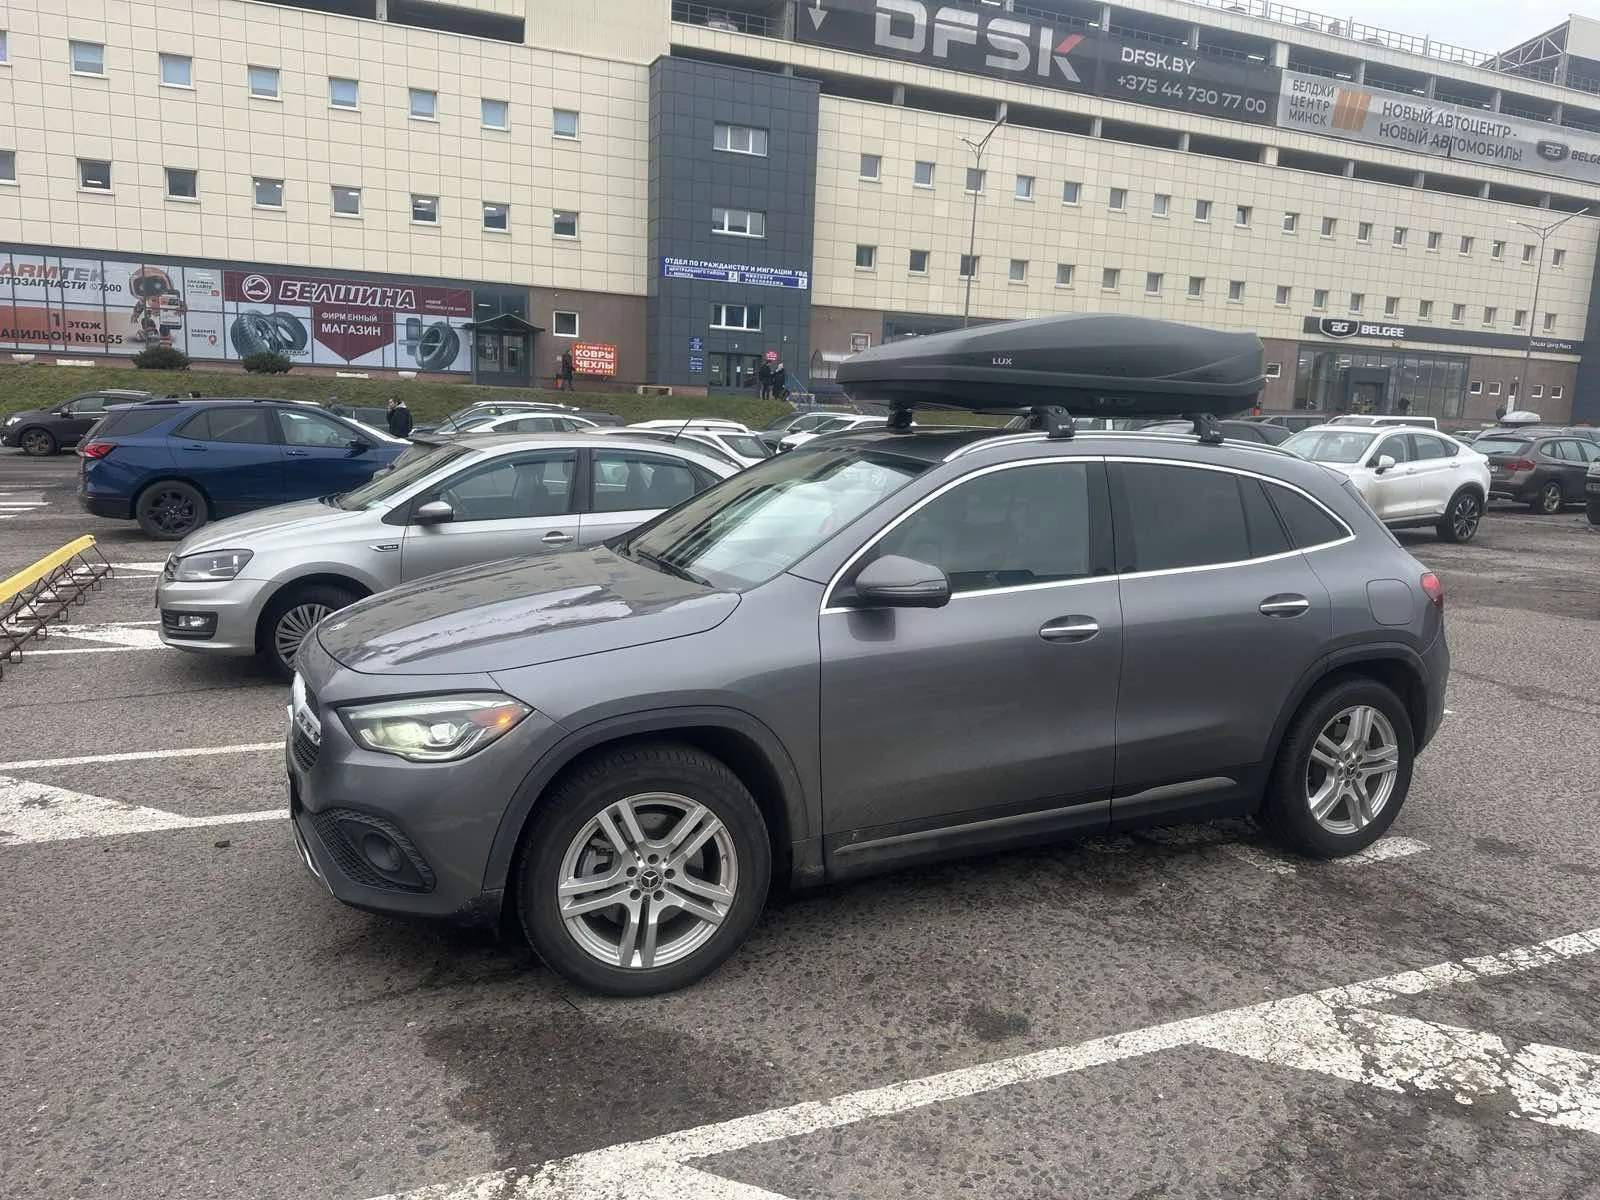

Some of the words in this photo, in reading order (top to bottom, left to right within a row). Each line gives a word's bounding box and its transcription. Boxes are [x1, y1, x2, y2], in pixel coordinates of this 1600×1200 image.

[874, 0, 1086, 83] DFSK
[1121, 46, 1196, 75] DFSK.BY
[1116, 74, 1158, 94] +375
[1161, 81, 1184, 99] 44
[1186, 86, 1218, 105] 730
[1221, 93, 1242, 109] 77
[1245, 97, 1267, 114] 00
[1293, 79, 1335, 98] БЕЛДЖИ
[1290, 94, 1330, 112] ЦЕНТР
[1288, 109, 1328, 128] МИНСК
[1382, 101, 1433, 125] НОВЫЙ
[1435, 112, 1511, 139] АВТОЦЕНТР
[1379, 122, 1429, 145] НОВЫЙ
[664, 257, 688, 265] ОТДЕЛ
[699, 261, 749, 272] ГРАЖДАНСТВУ
[756, 267, 793, 276] МИГРАЦИИ
[279, 280, 416, 309] БЕЛШИНА
[52, 312, 60, 326] 1
[68, 320, 101, 330] этаж
[321, 312, 378, 322] ФИРМЕННЫЙ
[321, 323, 381, 336] МАГАЗИН
[1361, 324, 1405, 337] BELGEE
[575, 349, 614, 359] КОВРЫ
[992, 357, 1012, 365] LUX
[575, 360, 614, 369] ЧЕХЛЫ
